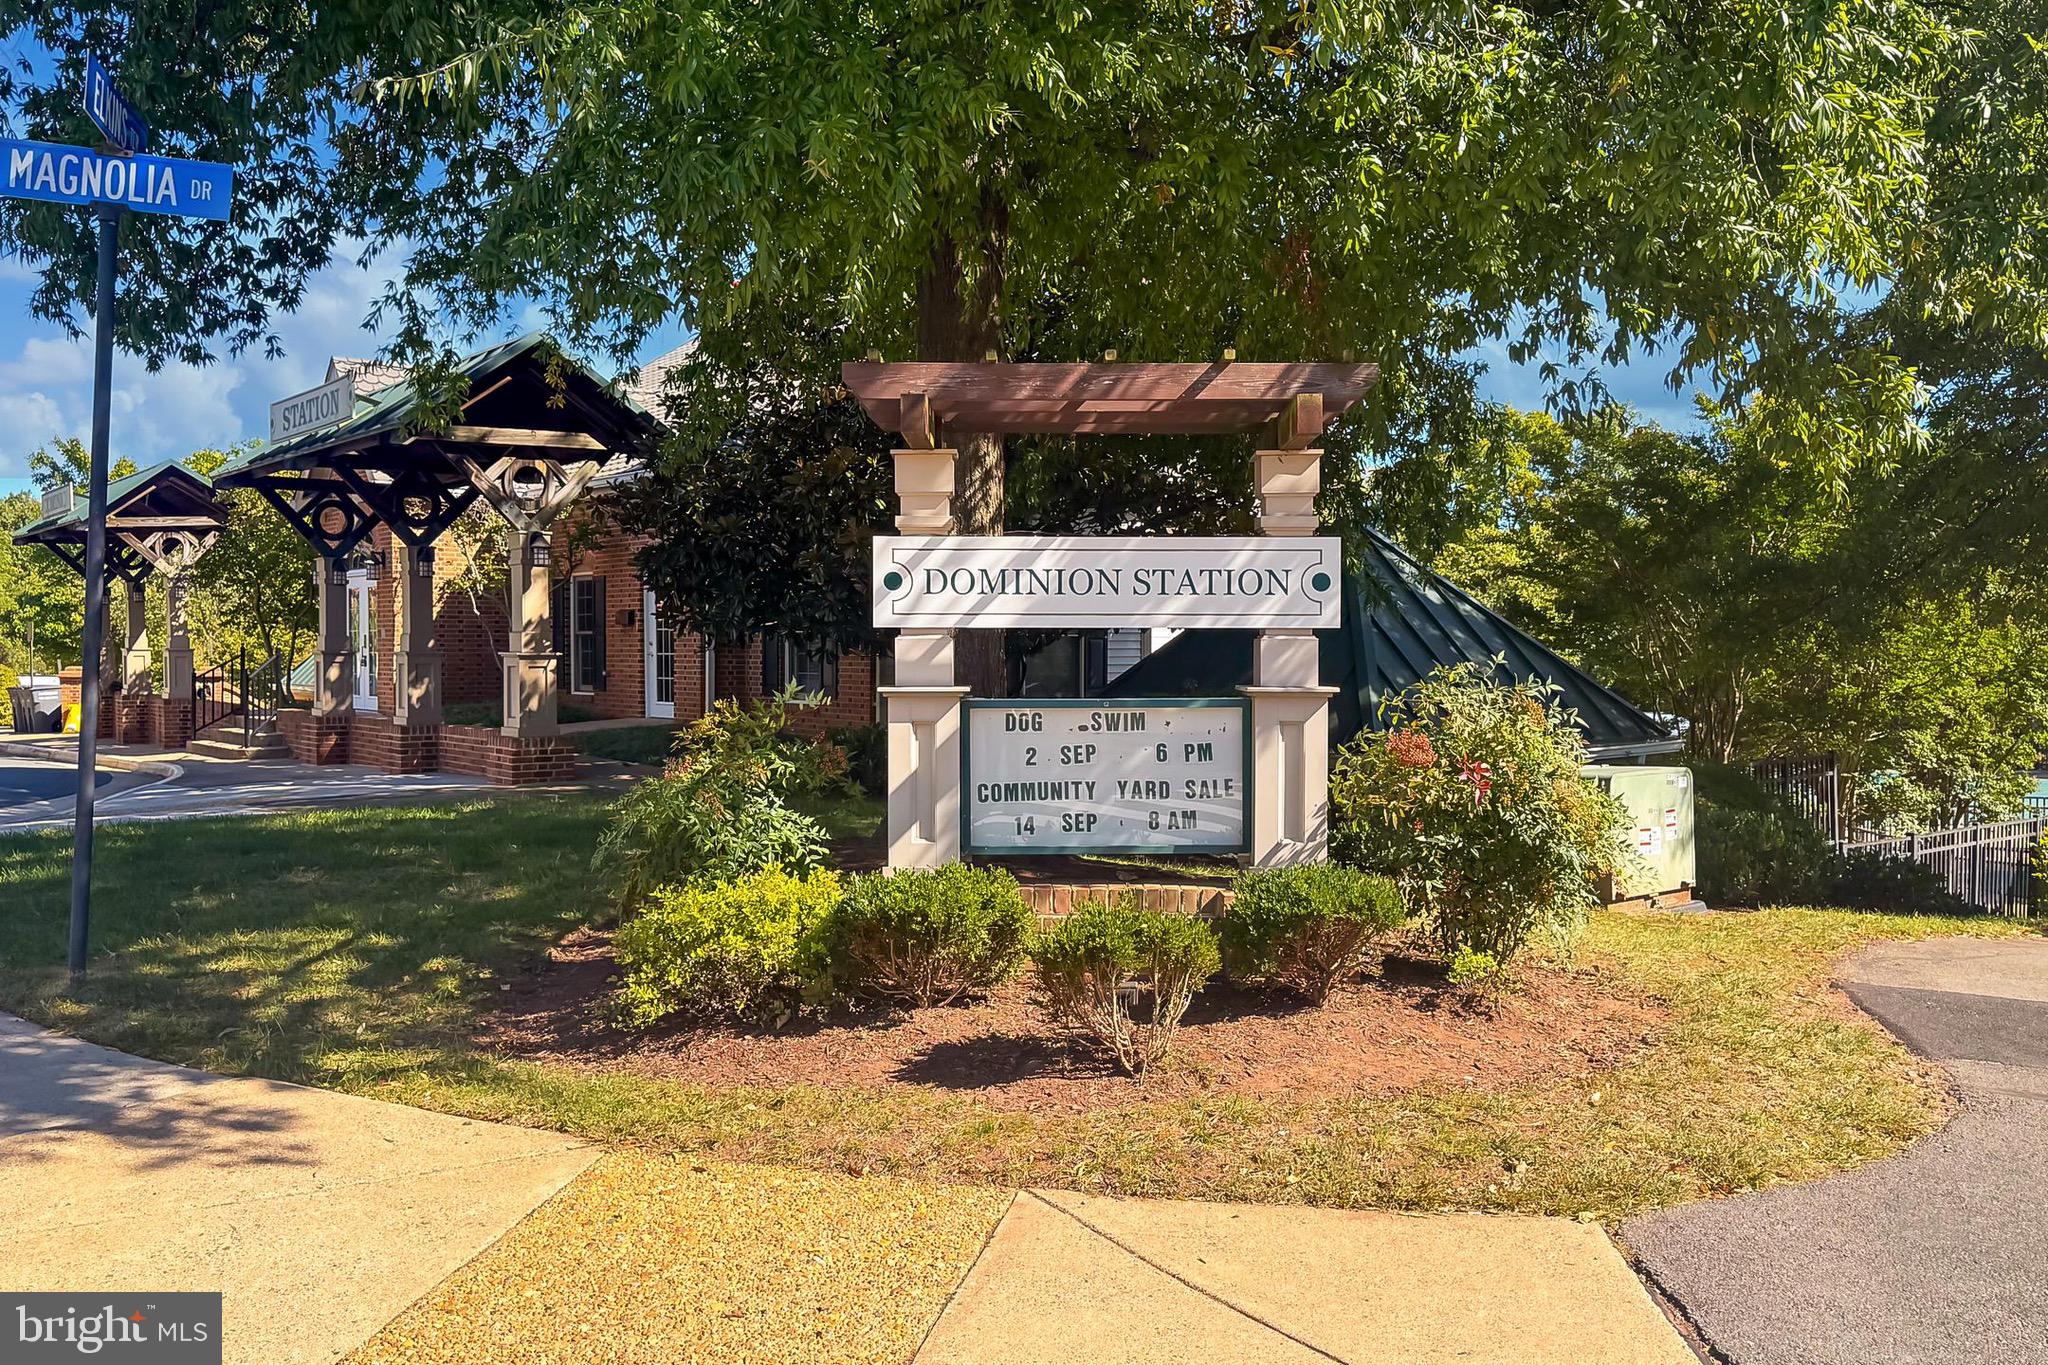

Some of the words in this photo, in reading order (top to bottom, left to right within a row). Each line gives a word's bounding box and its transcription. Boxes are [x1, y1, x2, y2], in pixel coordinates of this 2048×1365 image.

[94, 71, 128, 149] ELKINS
[9, 148, 178, 207] MAGNOLIA
[190, 179, 212, 201] DR
[282, 388, 340, 432] STATION
[923, 568, 1121, 596] DOMINION
[1132, 567, 1293, 597] STATION
[1005, 712, 1043, 732] DOG
[1090, 711, 1146, 732] SWIM
[1025, 746, 1037, 767] 2
[1060, 744, 1097, 765] SEP
[1156, 742, 1168, 763] 6
[1184, 742, 1214, 763] PM
[977, 780, 1096, 803] COMMUNITY
[1117, 780, 1170, 799] YARD
[1185, 778, 1234, 799] SALE
[1014, 815, 1036, 836] 14
[1061, 812, 1098, 833] SEP
[1149, 811, 1160, 831] 8
[1167, 810, 1198, 830] AM
